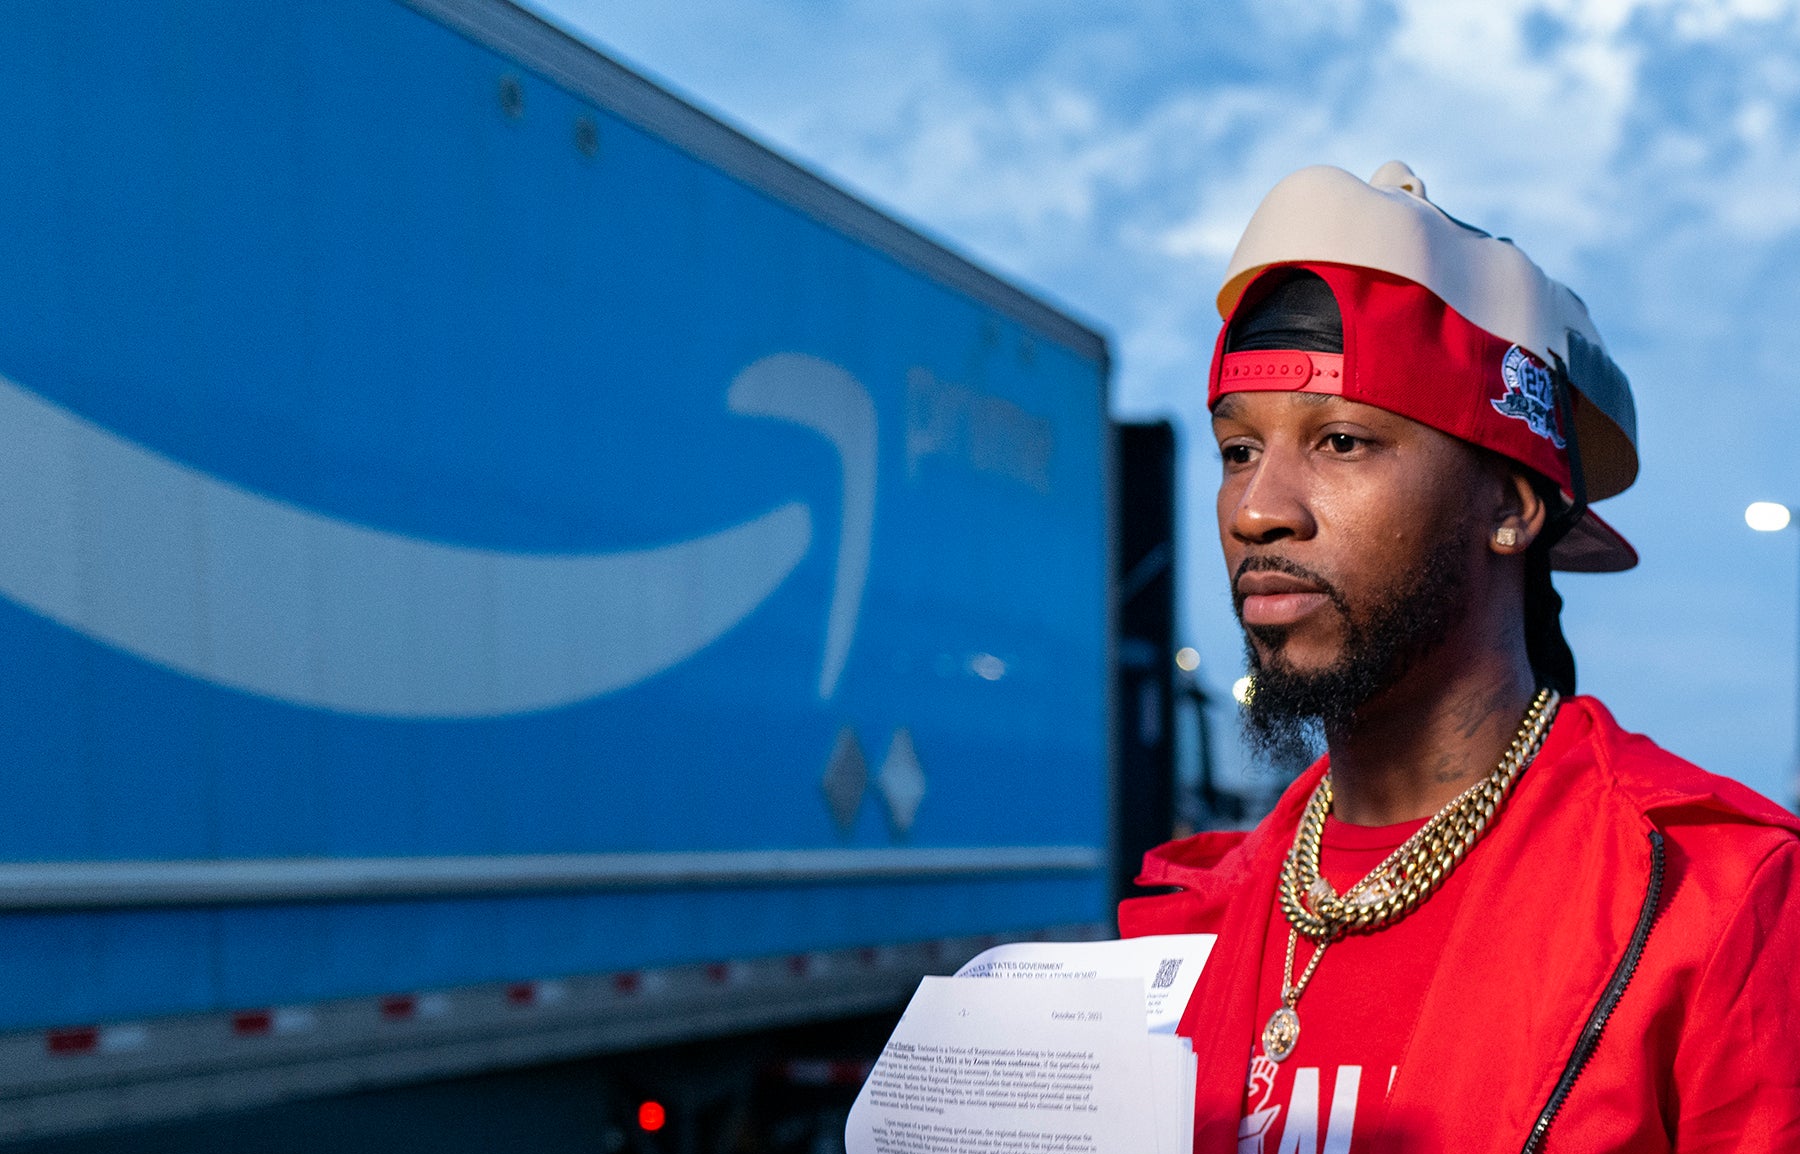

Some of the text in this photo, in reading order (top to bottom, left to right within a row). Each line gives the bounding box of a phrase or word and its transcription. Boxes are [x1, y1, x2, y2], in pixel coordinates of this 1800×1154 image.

[1525, 367, 1549, 402] 27
[987, 961, 1018, 971] STATES
[1018, 961, 1064, 971] GOVERNMENT
